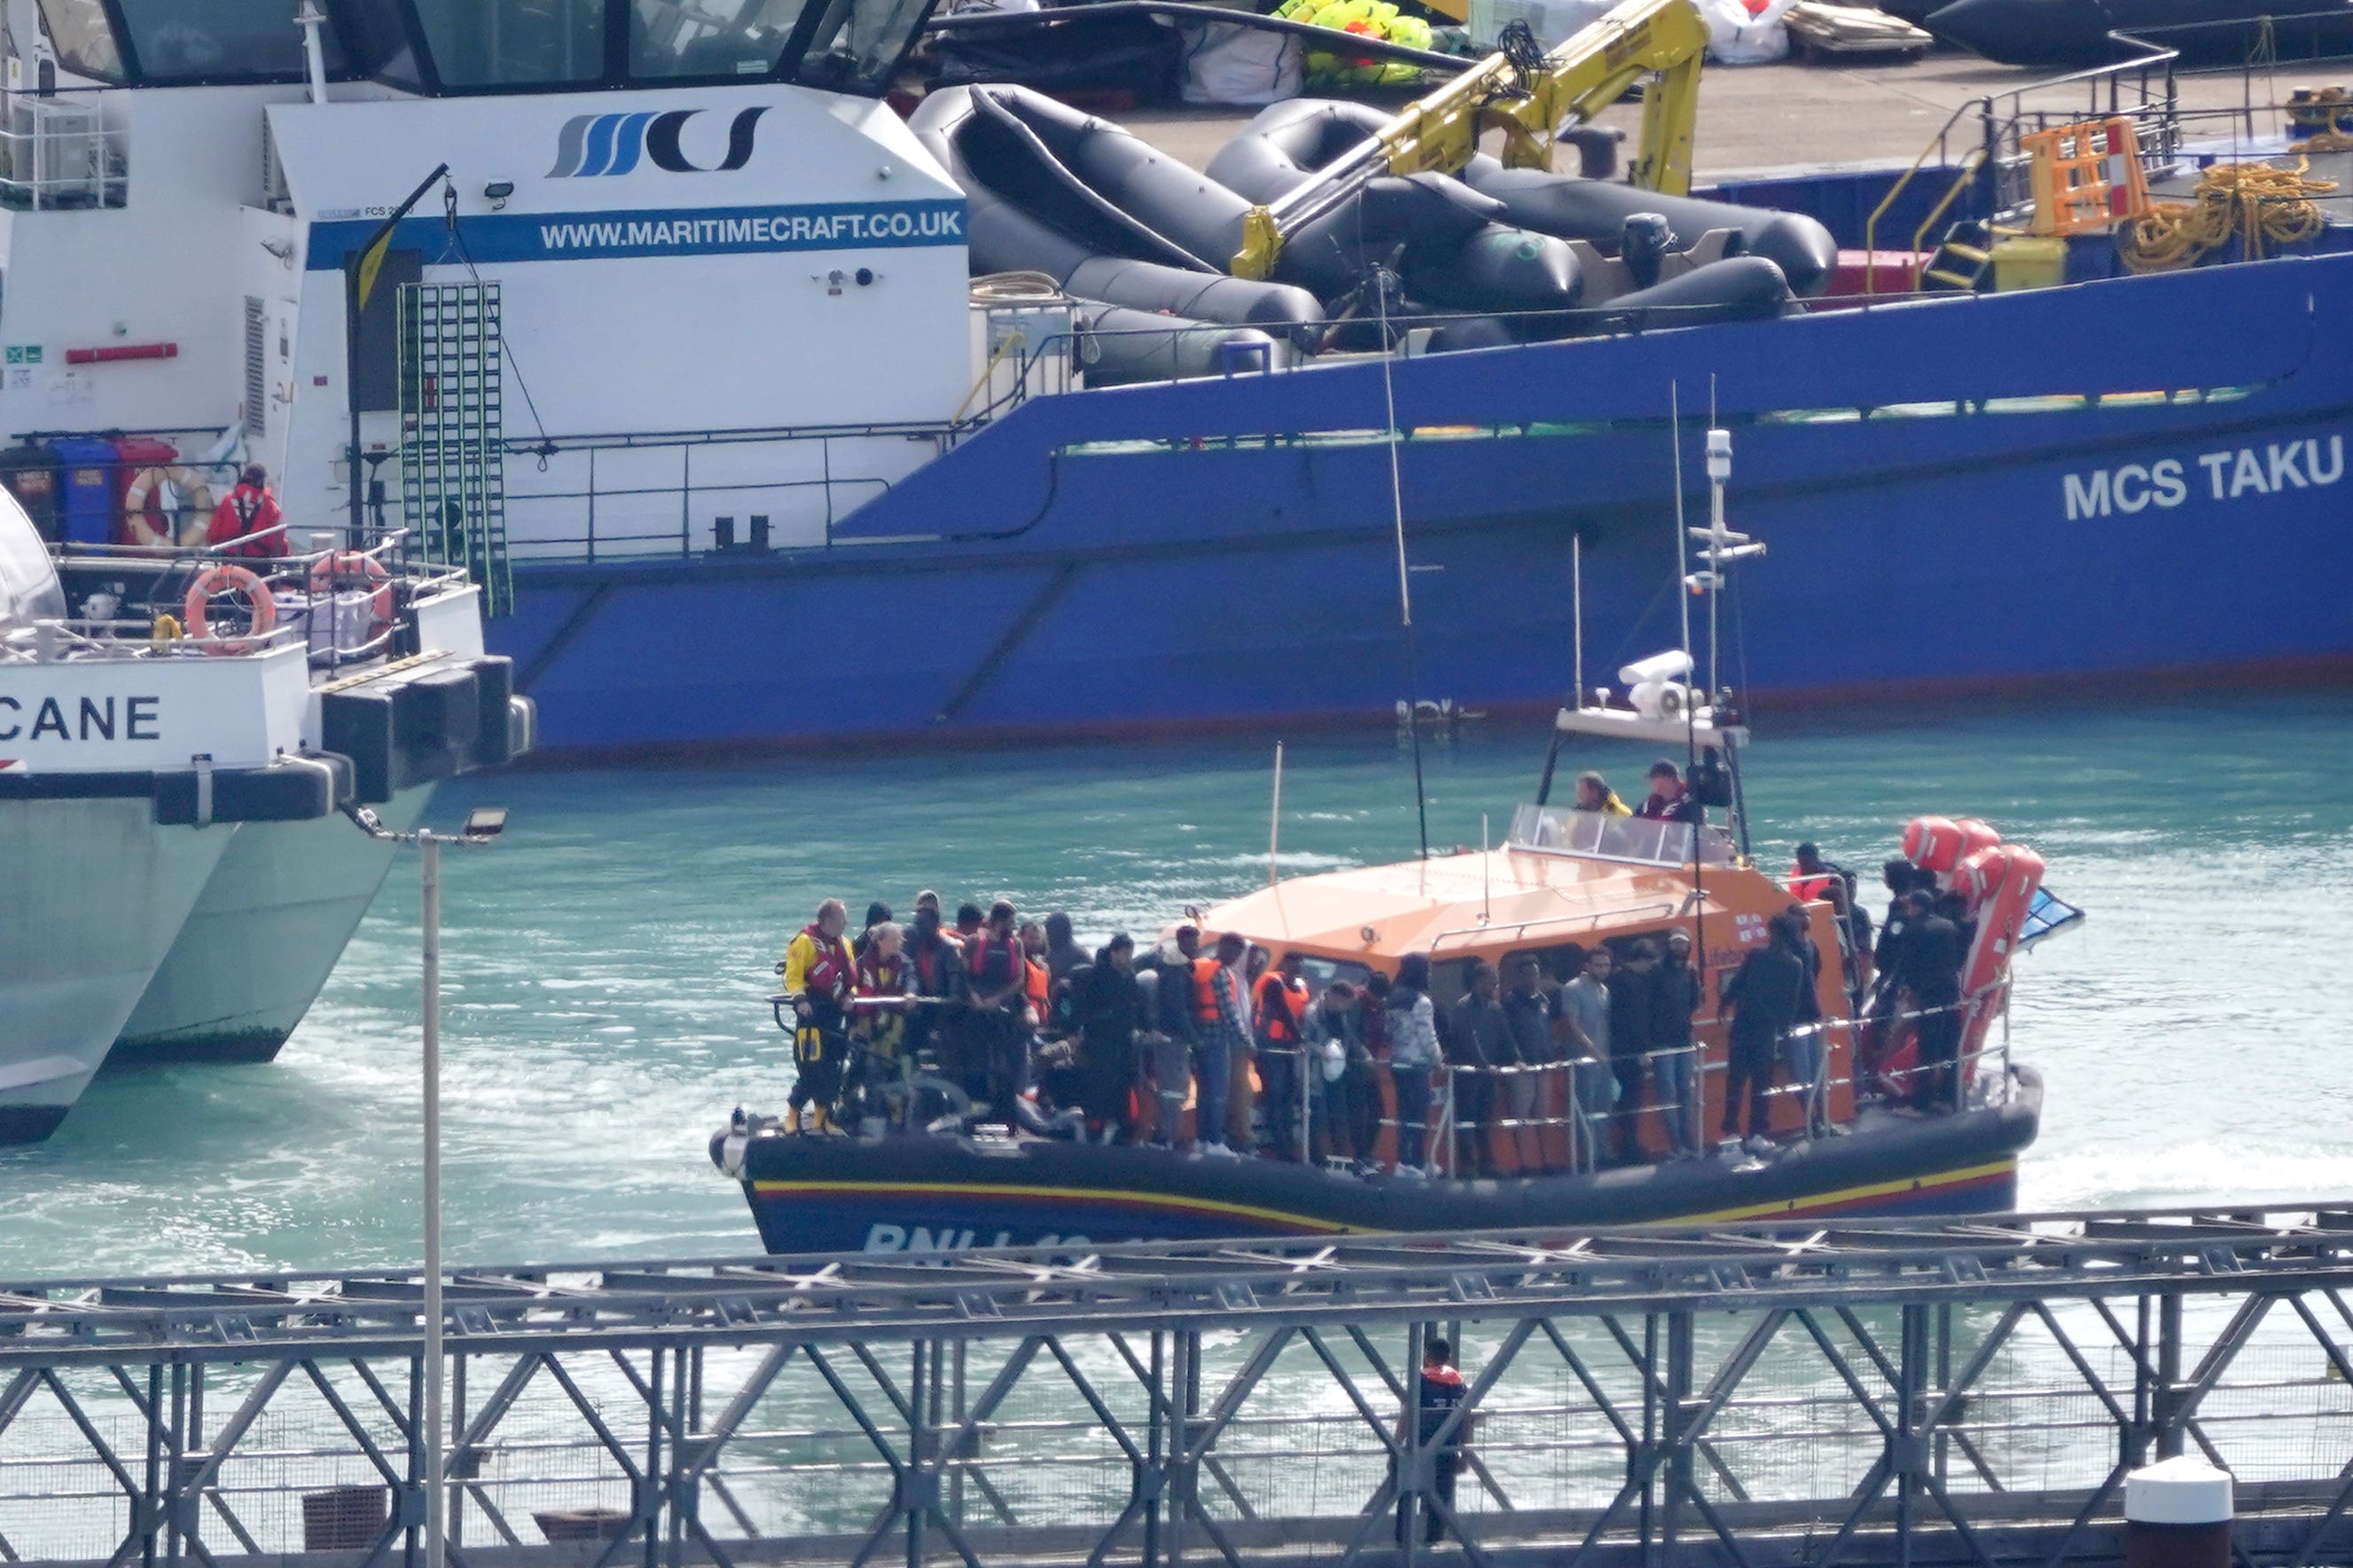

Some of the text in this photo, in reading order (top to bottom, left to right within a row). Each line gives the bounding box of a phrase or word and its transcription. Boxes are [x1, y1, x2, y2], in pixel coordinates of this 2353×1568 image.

[364, 206, 386, 216] FCS
[541, 211, 961, 248] WWW.MARITIMECRAFT.CO.UK
[2064, 435, 2345, 520] MCS TAKU
